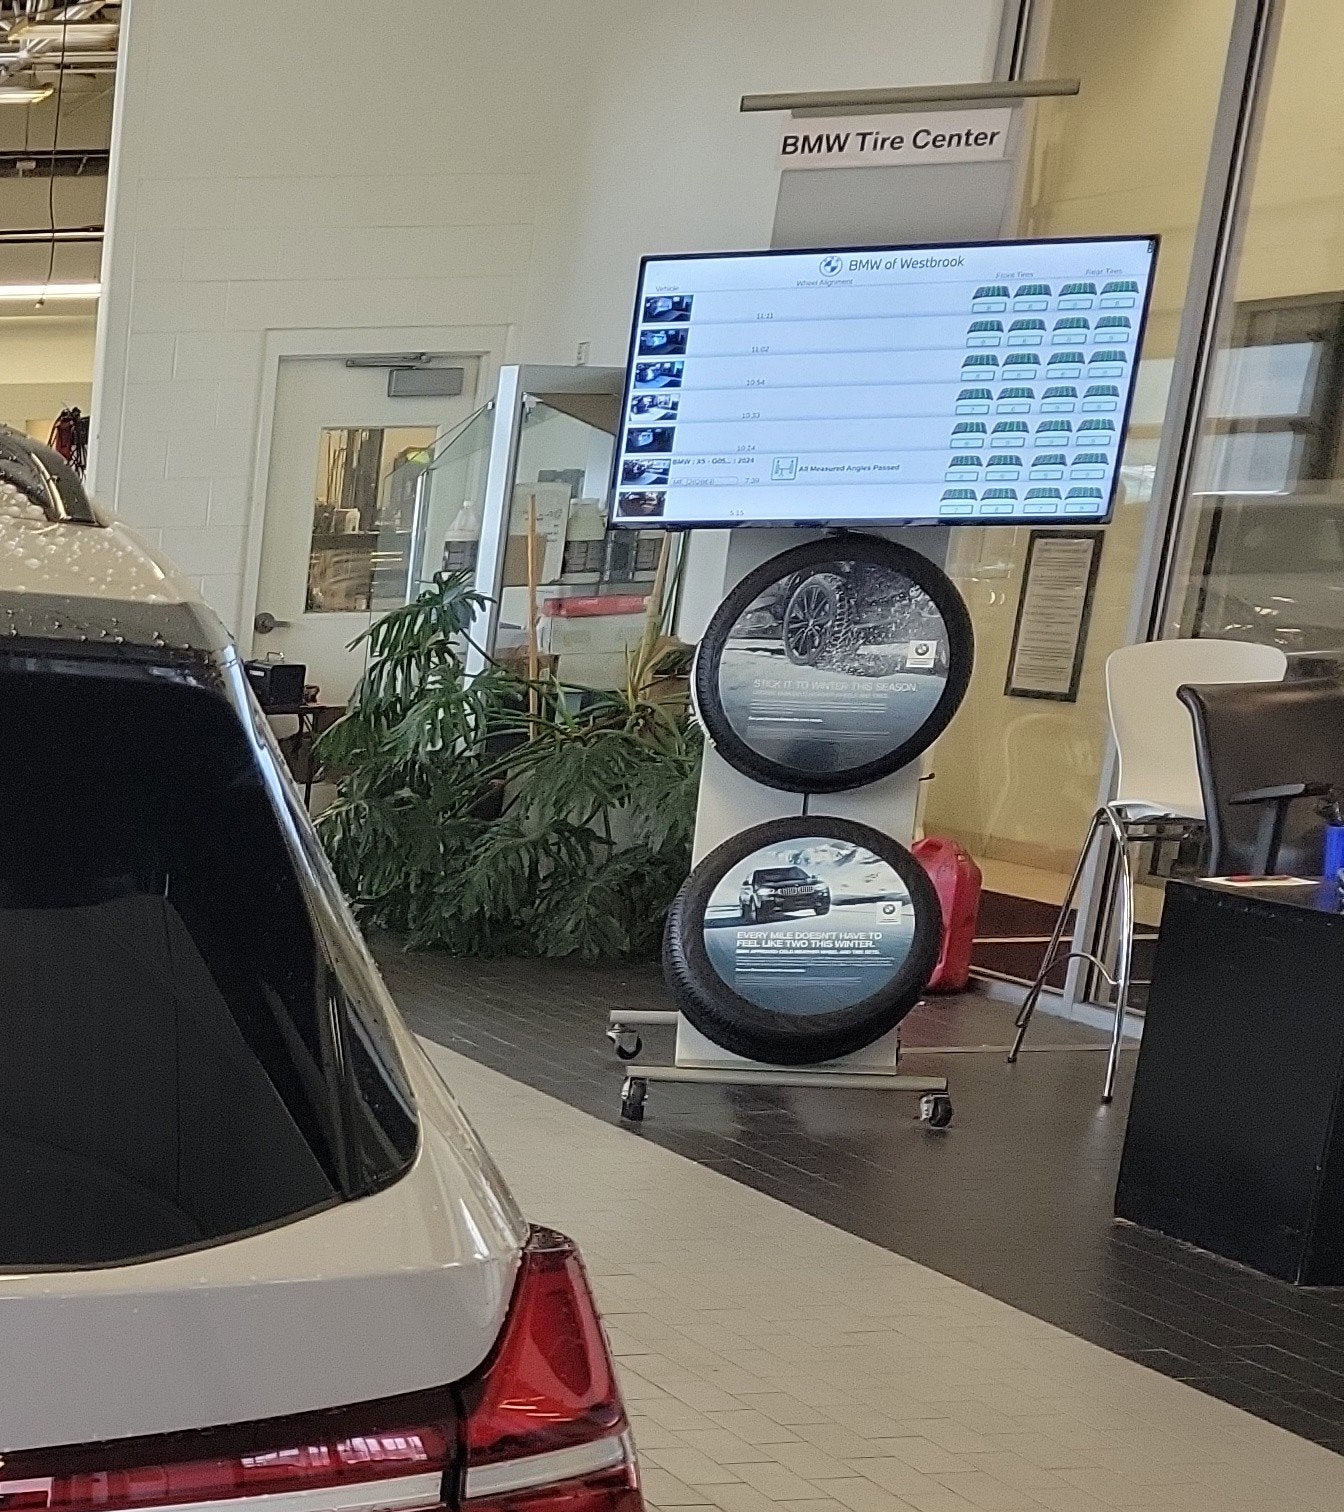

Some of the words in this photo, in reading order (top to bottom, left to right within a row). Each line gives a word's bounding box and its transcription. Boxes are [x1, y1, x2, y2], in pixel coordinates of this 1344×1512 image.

[781, 132, 850, 155] BMW
[856, 130, 904, 152] Tire
[912, 128, 1000, 150] Center
[848, 258, 883, 272] BMW
[884, 258, 897, 270] of
[900, 256, 965, 270] Westbrook
[845, 464, 871, 473] Angles
[754, 679, 782, 689] STICK
[796, 680, 809, 690] TO
[812, 681, 850, 691] WINTER
[853, 681, 874, 691] THIS
[737, 931, 768, 939] EVERY
[770, 932, 794, 940] MILE
[795, 932, 837, 940] DOESN'T
[839, 932, 866, 940] HAVE
[869, 932, 883, 940] TO
[736, 939, 761, 948] FEEL
[762, 940, 783, 948] LIKE
[785, 940, 809, 948] TWO
[811, 940, 833, 948] THIS
[834, 940, 876, 948] WINTER.
